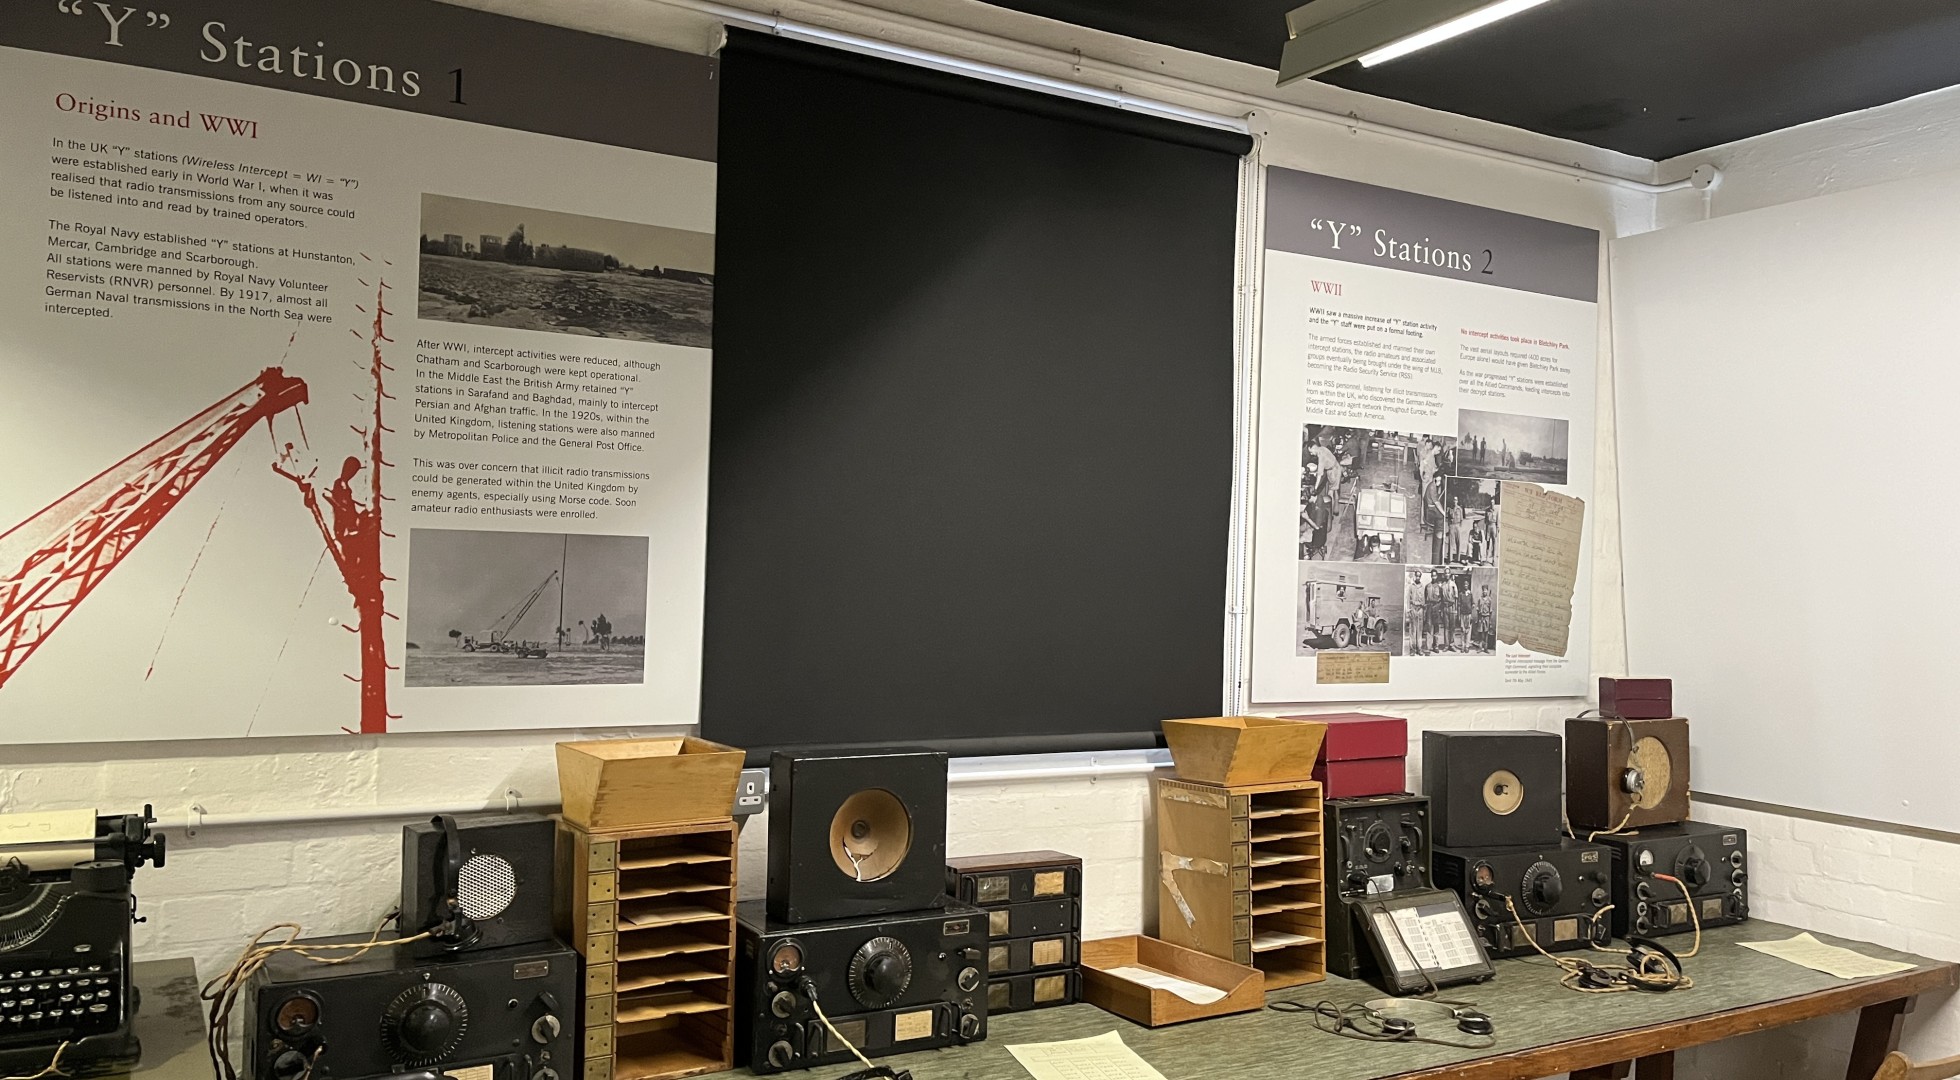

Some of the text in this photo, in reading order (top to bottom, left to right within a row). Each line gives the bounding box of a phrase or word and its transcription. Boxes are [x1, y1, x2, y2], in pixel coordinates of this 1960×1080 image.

[57, 0, 467, 106] “Y” Stations 1
[55, 92, 259, 139] Origins and WWI
[51, 156, 333, 201] were established early in World War I, when it was
[53, 137, 63, 148] In
[68, 139, 86, 151] the
[90, 142, 108, 154] UK
[112, 145, 130, 156] “Y”
[134, 149, 178, 164] stations
[182, 155, 235, 172] (Wireless
[238, 163, 288, 179] Intercept
[306, 173, 322, 184] WI
[340, 178, 359, 190] “Y”)
[50, 186, 307, 228] be listened into and read by trained operators.
[51, 172, 355, 219] realised that radio transmissions from any source could
[48, 219, 355, 266] The Royal Navy established “Y” stations at Hunstanton,
[48, 235, 258, 270] Mercar, Cambridge and Scarborough.
[1310, 218, 1494, 275] “Y” Stations 2
[46, 252, 328, 292] All stations were manned by Royal Navy Volunteer
[46, 269, 328, 308] Reservists (RNVR) personnel. By 1917, almost all
[1311, 280, 1342, 296] WWII
[45, 285, 332, 323] German Naval transmissions in the North Sea were
[45, 302, 113, 318] intercepted.
[1309, 307, 1325, 315] WWII
[1342, 312, 1363, 321] massive
[1364, 315, 1385, 323] increase
[1402, 320, 1419, 328] station
[1420, 323, 1437, 331] activity
[1388, 327, 1404, 335] formal
[1405, 329, 1423, 339] footing.
[416, 339, 661, 372] After WWI, intercept activities were reduced, although
[416, 353, 640, 383] Chatham and Scarborough were kept operational.
[416, 368, 633, 395] In the Middle East the British Army retained “Y”
